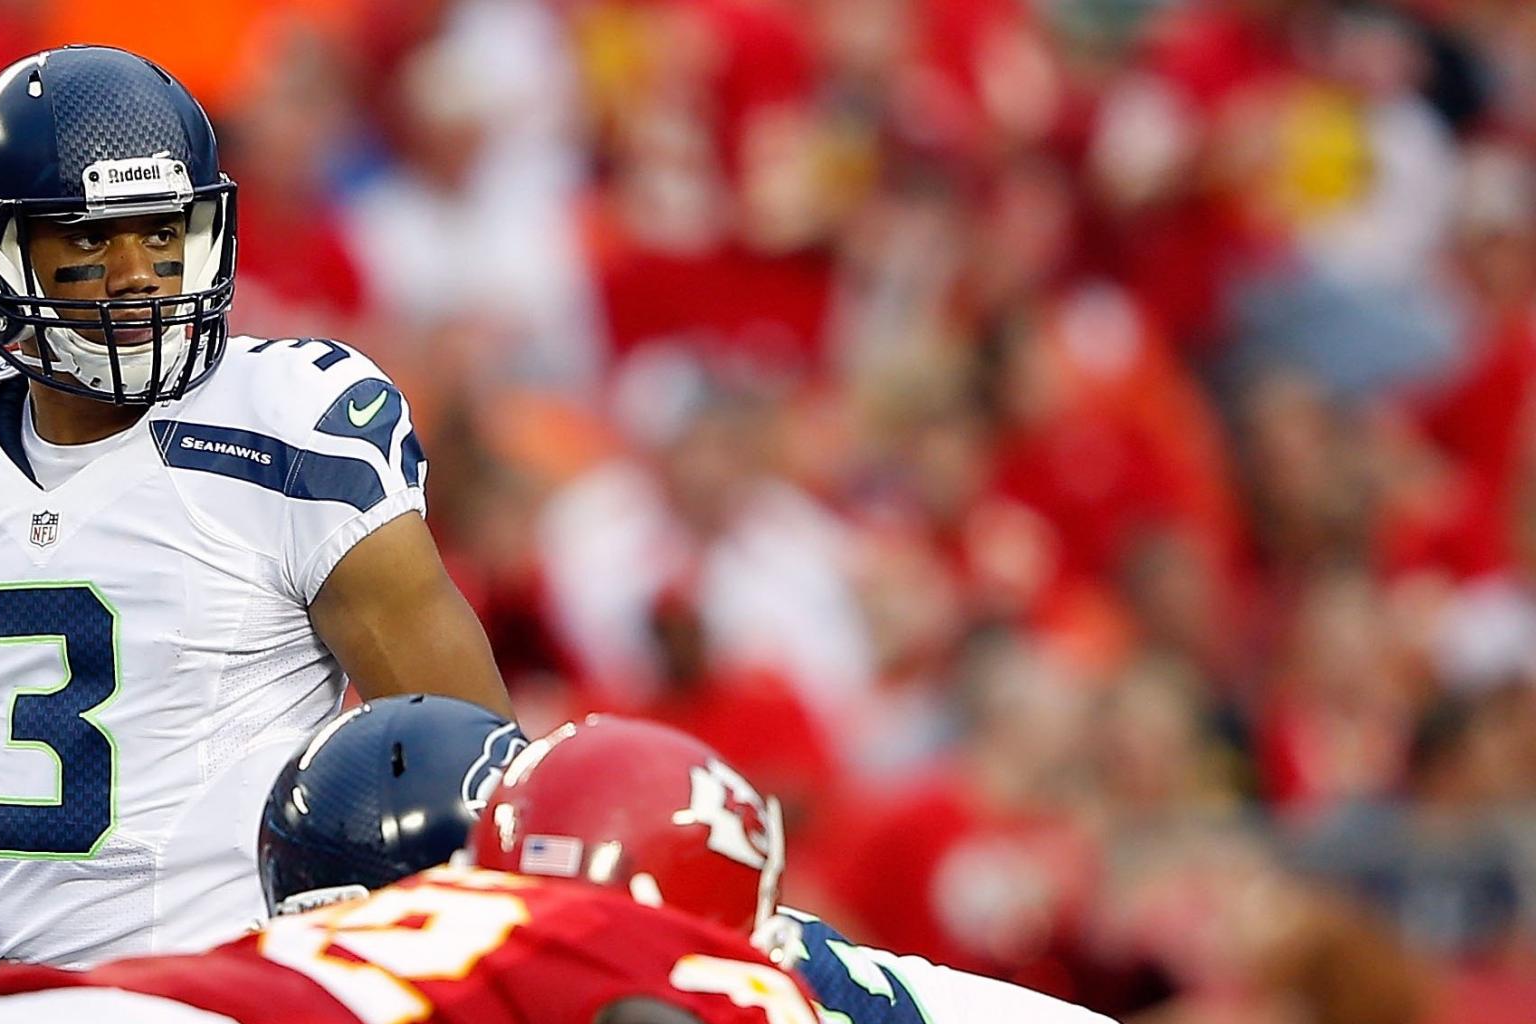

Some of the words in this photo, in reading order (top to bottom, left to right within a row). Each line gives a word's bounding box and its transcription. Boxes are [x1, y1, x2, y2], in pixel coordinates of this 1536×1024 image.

[108, 165, 160, 183] Riddell
[180, 436, 272, 466] SEAHAWKS
[33, 526, 54, 543] NFL
